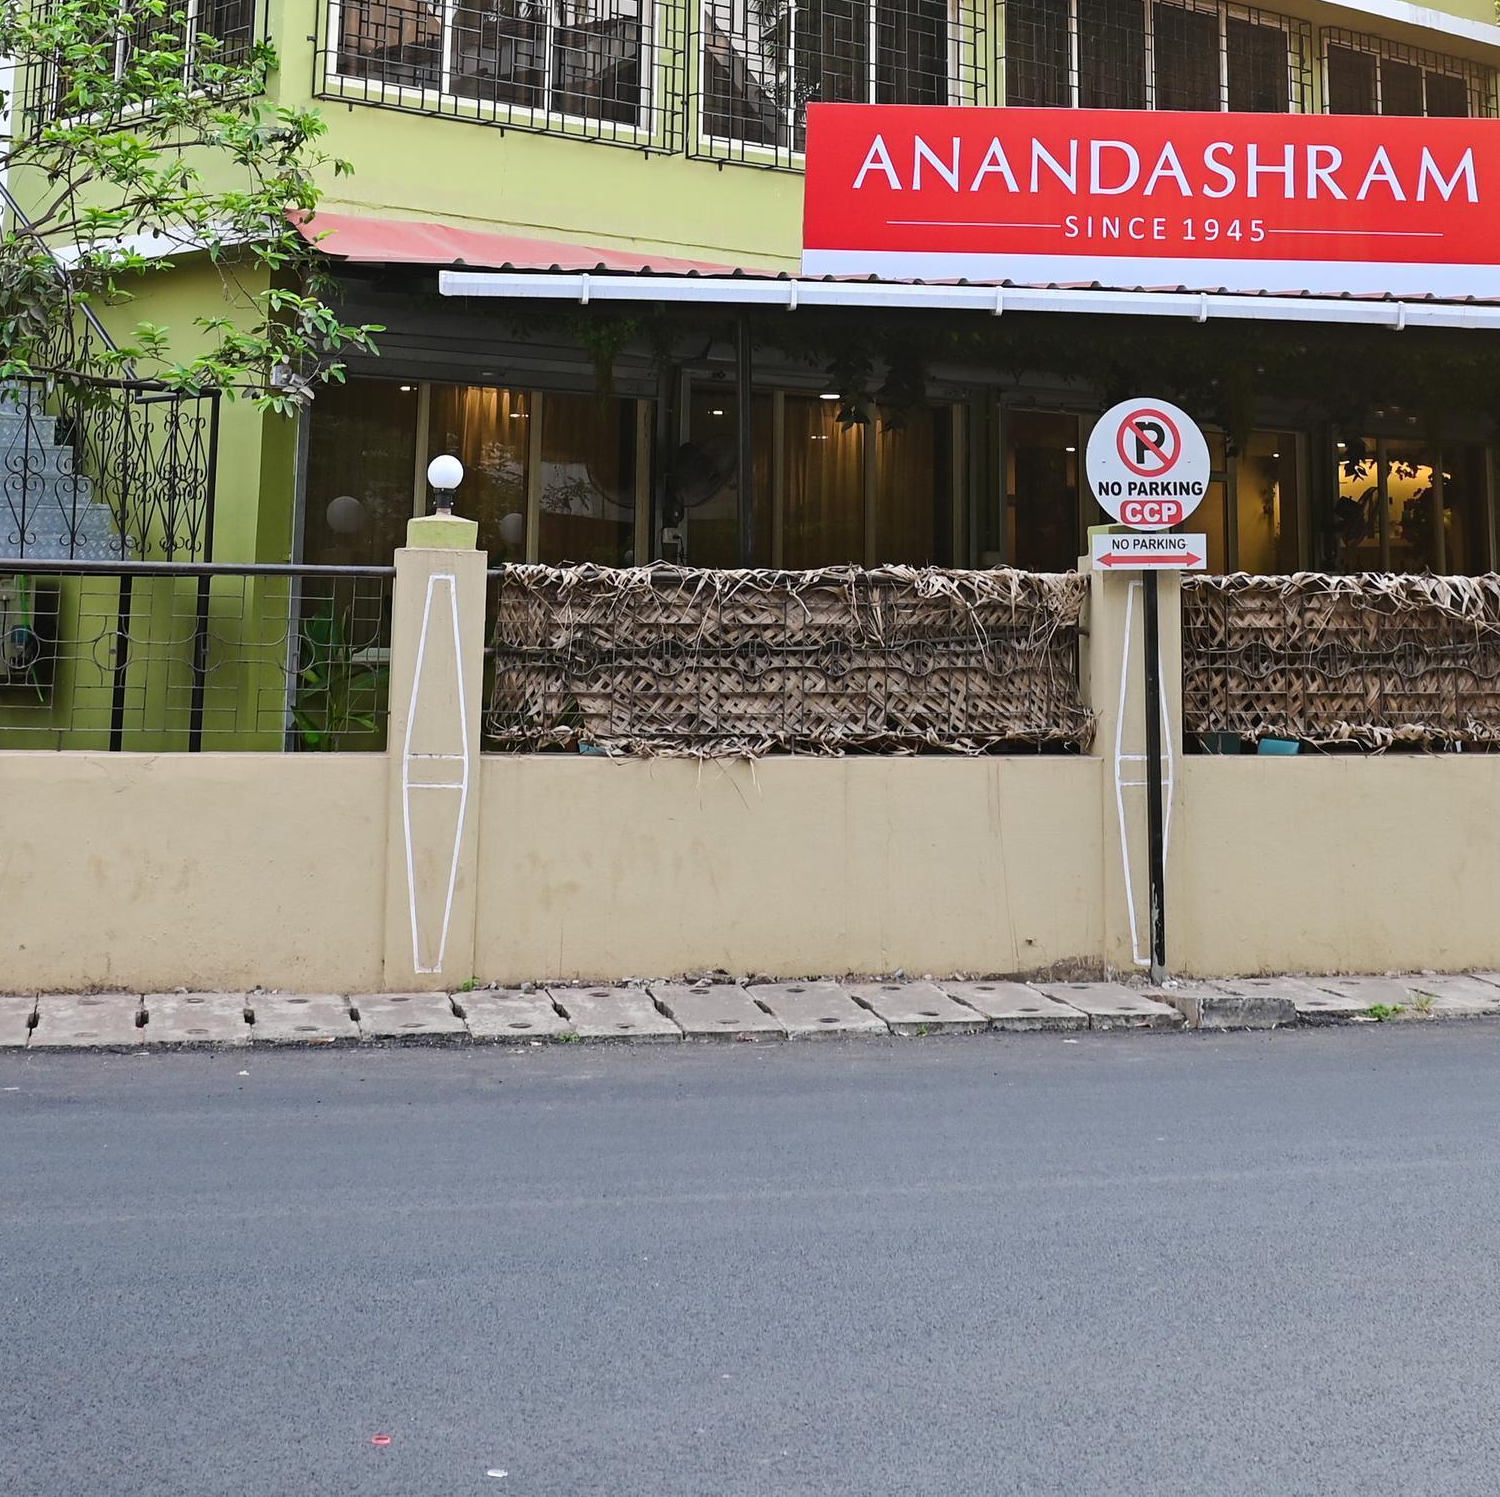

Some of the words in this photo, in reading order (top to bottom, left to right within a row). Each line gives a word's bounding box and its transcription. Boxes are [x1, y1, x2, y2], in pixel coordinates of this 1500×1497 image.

[852, 133, 1480, 203] ANANDASHRAM
[1065, 214, 1167, 241] SINCE
[1182, 217, 1267, 244] 1945
[1099, 481, 1122, 496] NO
[1128, 481, 1203, 496] PARKING
[1125, 502, 1177, 523] CCP
[1112, 538, 1130, 550] NO
[1133, 538, 1187, 550] PARKING
